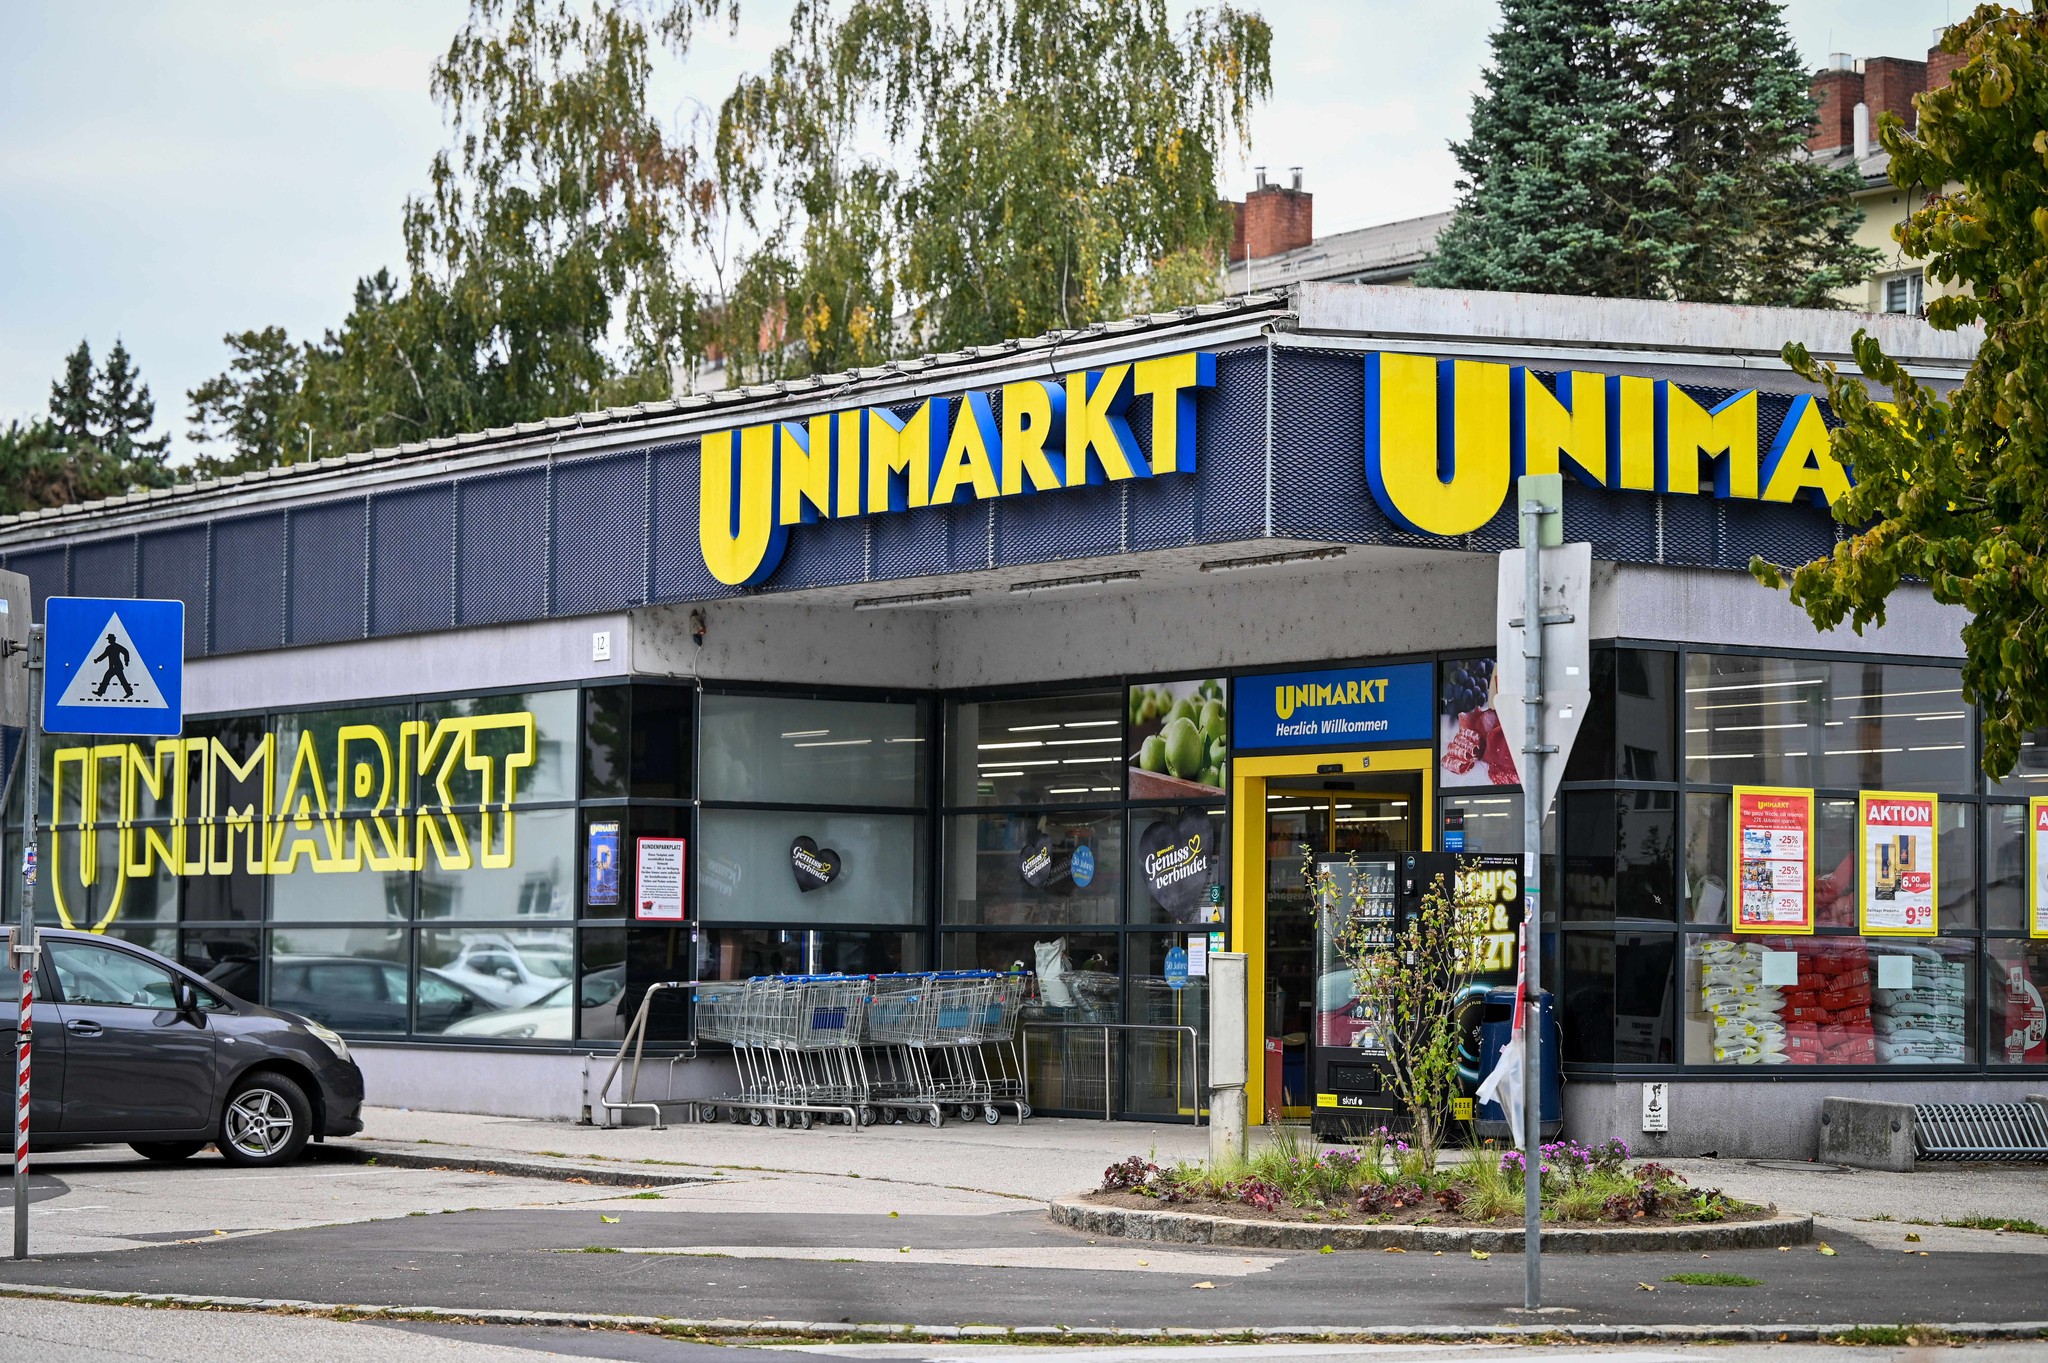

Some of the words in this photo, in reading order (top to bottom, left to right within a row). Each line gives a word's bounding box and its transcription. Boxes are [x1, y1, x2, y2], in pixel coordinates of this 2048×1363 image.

[1365, 352, 1930, 537] UNIMA
[700, 352, 1216, 586] UNIMARKT
[597, 636, 605, 650] 12
[1276, 679, 1388, 720] UNIMARKT
[1276, 720, 1318, 736] Herzlich
[1321, 719, 1388, 734] Willkommen
[1758, 801, 1789, 810] UNIMARKT
[1868, 805, 1929, 822] AKTION
[52, 712, 535, 934] UNIMARKT
[590, 824, 619, 836] UNIMARKT
[1779, 835, 1798, 844] -25%
[597, 845, 611, 881] P
[792, 846, 822, 868] Genuss
[1022, 854, 1042, 875] Genuss
[1028, 856, 1051, 878] verbindet
[1080, 860, 1093, 871] Jahre
[1145, 845, 1189, 882] Genuss
[795, 859, 830, 882] verbindet
[1156, 855, 1207, 889] verbindet
[1779, 866, 1798, 875] -25%
[1779, 898, 1798, 908] -25%
[1493, 903, 1509, 931] &
[1173, 962, 1187, 970] Jahre
[1342, 1096, 1358, 1105] skruf
